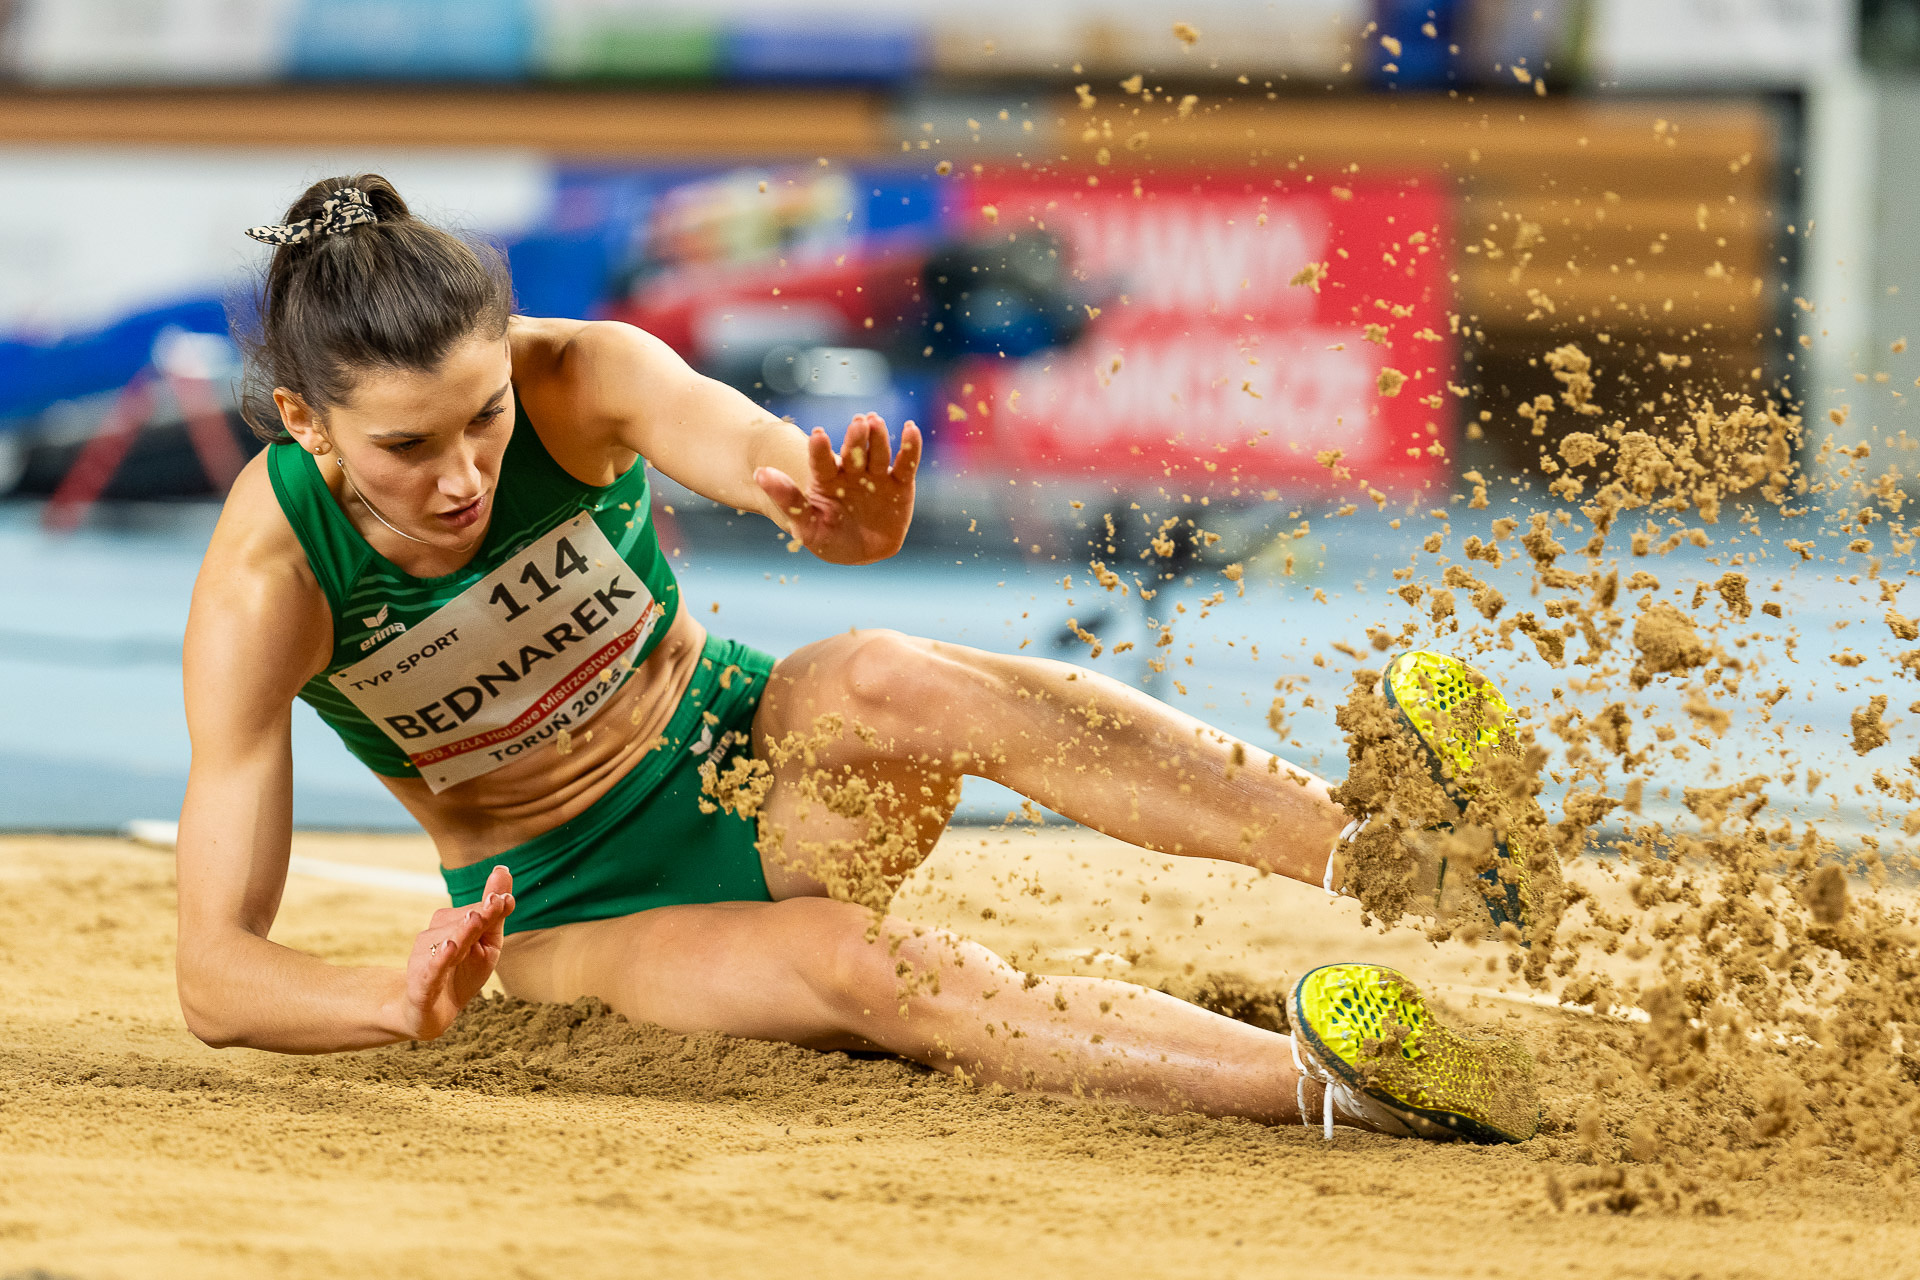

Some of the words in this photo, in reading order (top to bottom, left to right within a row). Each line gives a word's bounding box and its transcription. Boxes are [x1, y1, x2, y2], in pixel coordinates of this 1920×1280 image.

[489, 536, 590, 623] 114
[350, 670, 393, 691] TVP
[396, 628, 460, 674] SPORT
[360, 622, 407, 652] erima
[384, 575, 637, 740] BEDNAREK
[448, 736, 487, 754] PZLA
[486, 710, 541, 741] Halowe
[539, 644, 619, 712] Mistrzostwa
[488, 712, 572, 761] TORUŃ
